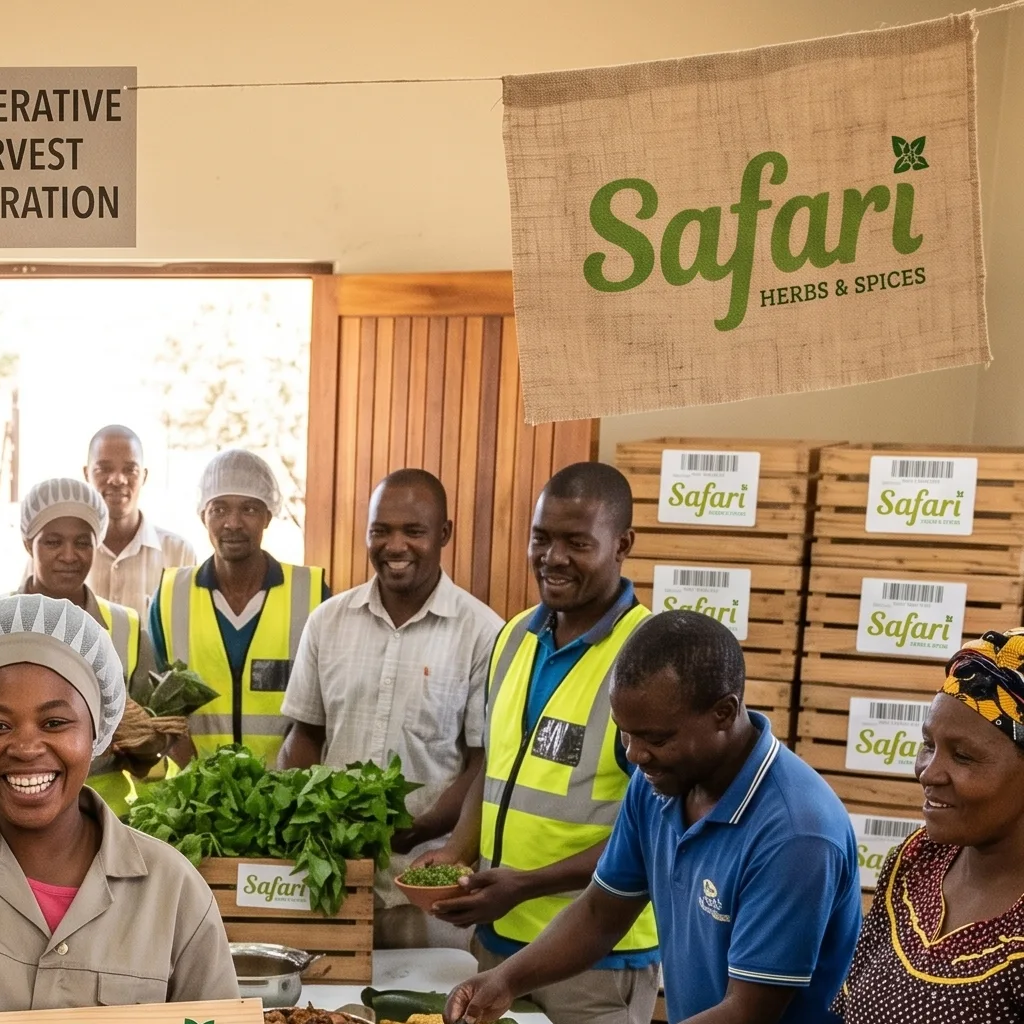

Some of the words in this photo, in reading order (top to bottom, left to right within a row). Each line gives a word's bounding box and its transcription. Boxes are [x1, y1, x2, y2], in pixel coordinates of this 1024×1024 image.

[583, 151, 923, 332] Safari
[760, 281, 829, 307] HERBS
[834, 279, 849, 297] &
[854, 266, 926, 294] SPICES
[668, 482, 745, 517] Safari
[876, 489, 961, 526] Safari
[867, 611, 950, 648] Safari
[243, 874, 307, 902] Safari
